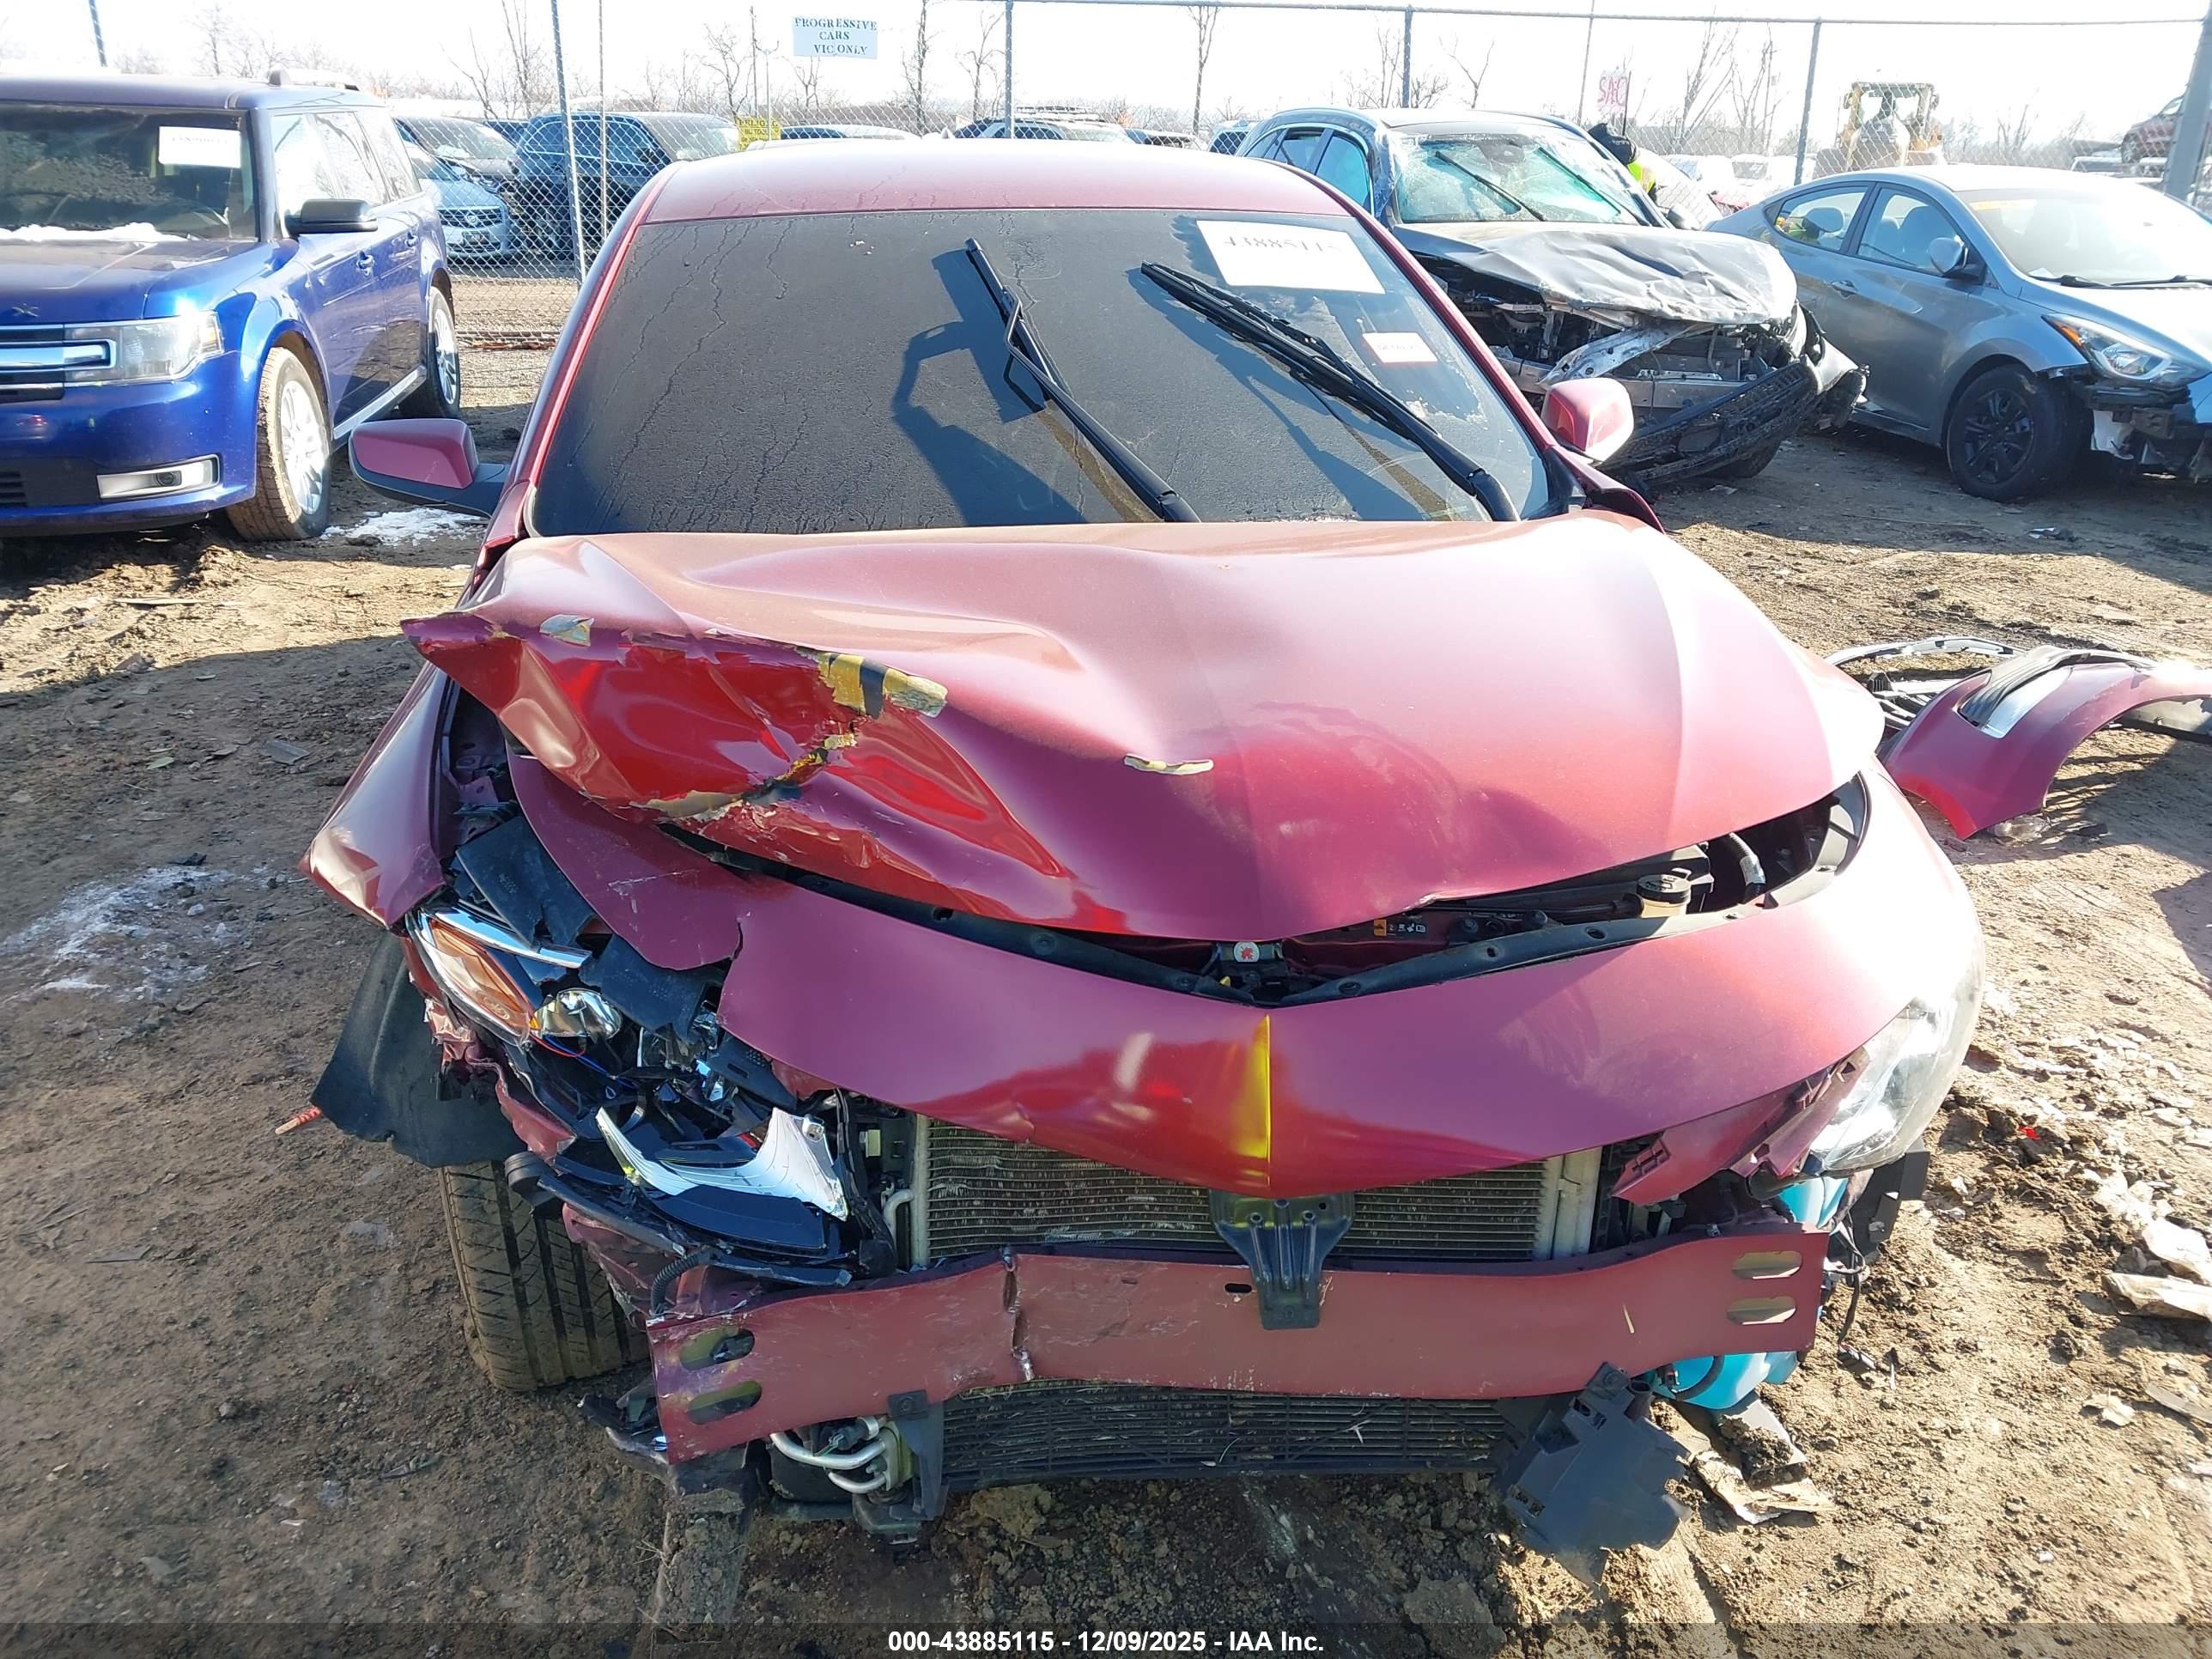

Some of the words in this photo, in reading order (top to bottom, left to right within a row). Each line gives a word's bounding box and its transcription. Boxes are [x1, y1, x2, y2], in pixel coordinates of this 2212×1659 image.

[794, 17, 877, 31] PROGRESSIVE
[819, 31, 850, 40] CARS
[837, 44, 867, 55] ONLY
